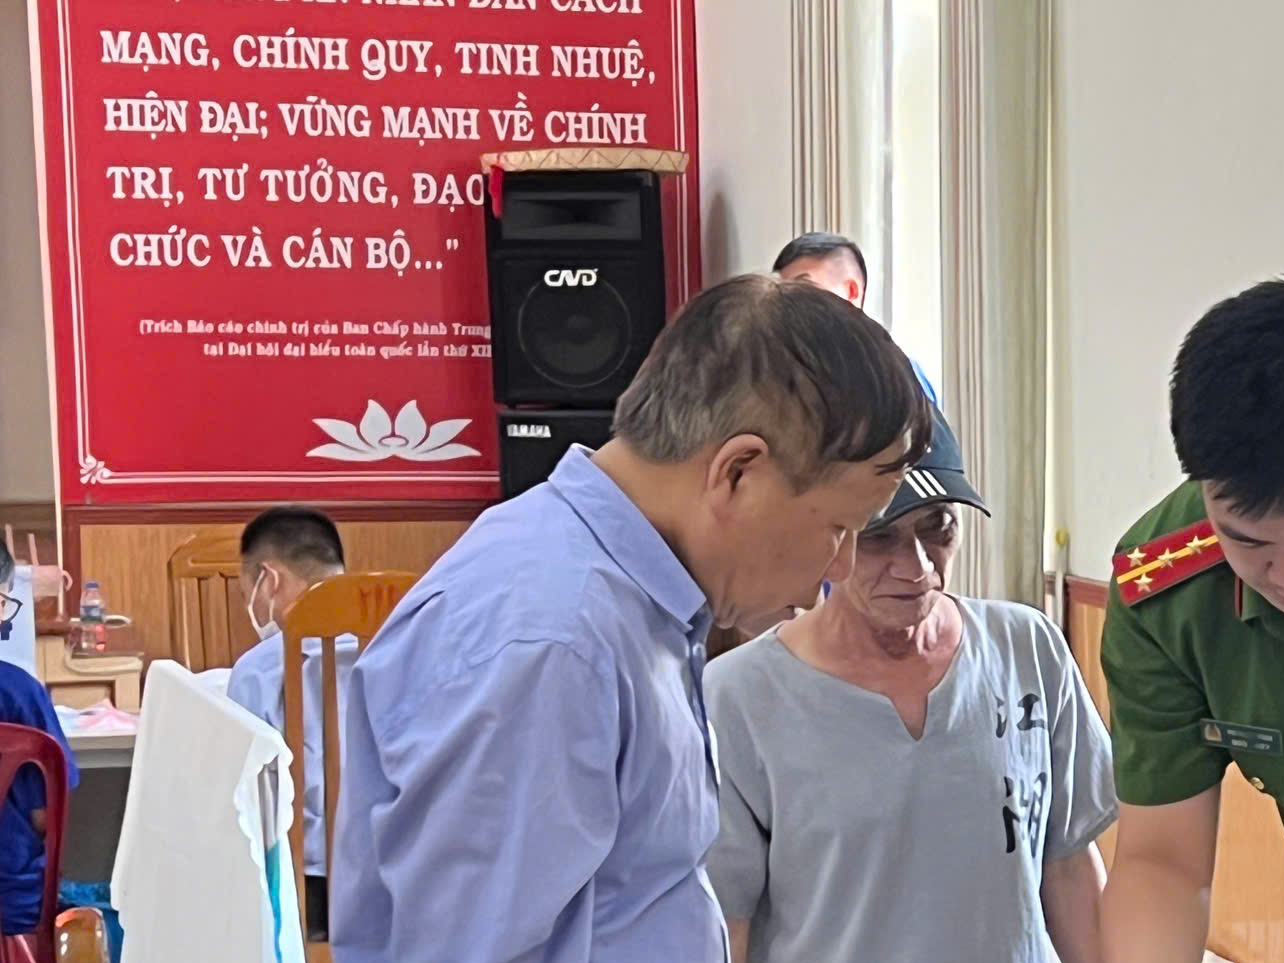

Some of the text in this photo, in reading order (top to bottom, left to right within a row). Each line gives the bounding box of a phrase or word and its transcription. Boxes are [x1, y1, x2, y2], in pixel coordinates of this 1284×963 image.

[100, 27, 655, 87] MẠNG, CHÍNH QUY, TINH NHUỆ,
[104, 91, 647, 146] HIỆN ĐẠI; VỮNG MẠNH VỀ CHÍNH
[107, 158, 484, 213] TRỊ, TƯ TƯỞNG, ĐẠO
[110, 225, 211, 267] CHỨC
[221, 226, 272, 267] VÀ
[283, 227, 354, 269] CÁN
